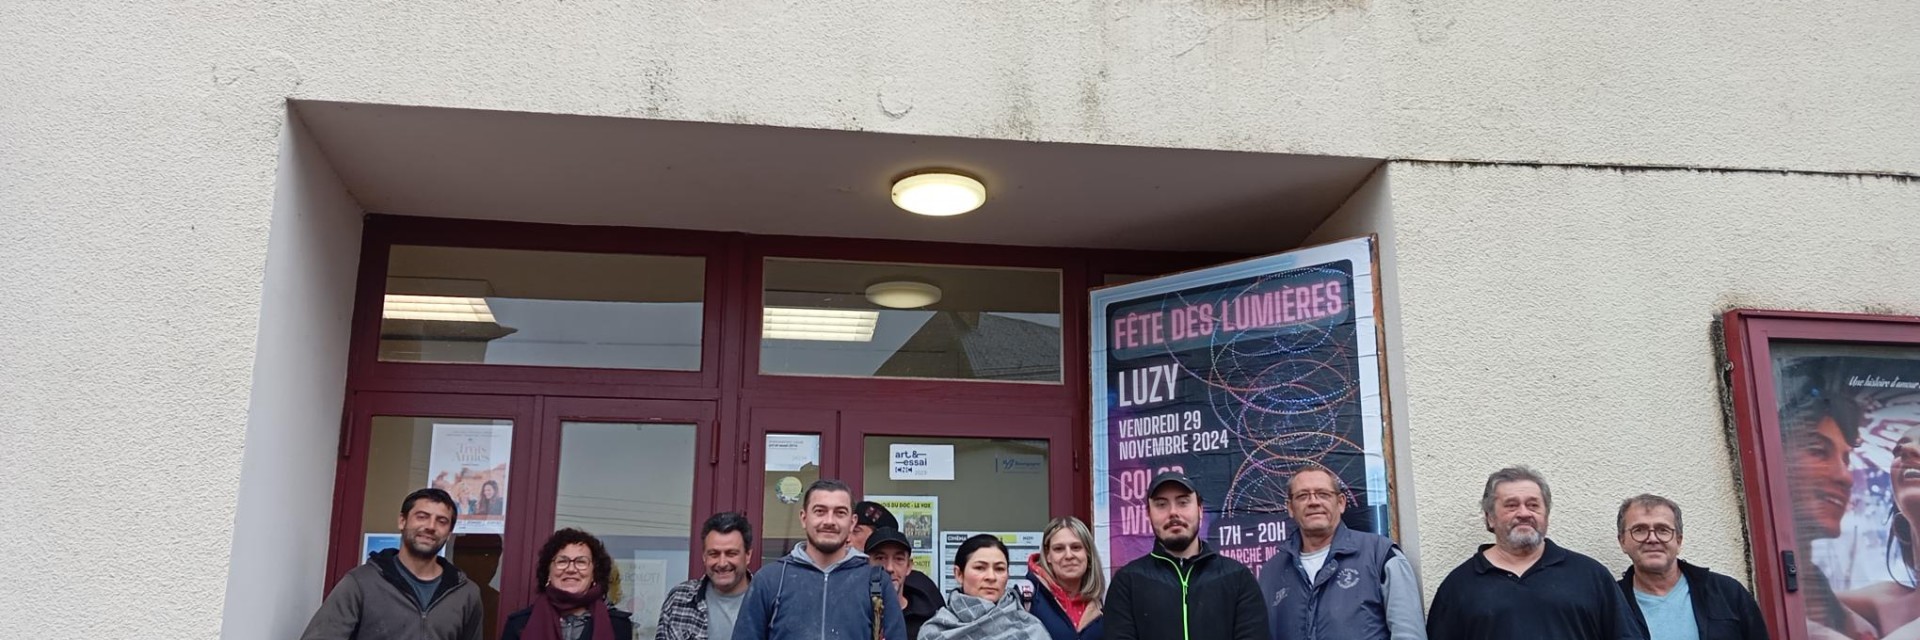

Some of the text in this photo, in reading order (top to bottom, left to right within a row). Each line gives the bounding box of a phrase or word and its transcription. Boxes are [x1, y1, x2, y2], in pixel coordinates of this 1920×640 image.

[1114, 280, 1343, 349] FÊTE DES LUMIÈRES
[1118, 363, 1179, 408] LUZY
[1118, 410, 1201, 439] VENDREDI 29
[895, 451, 911, 459] art
[1119, 429, 1229, 461] NOVEMBRE 2024
[904, 458, 927, 466] essai
[1219, 525, 1241, 546] 17H
[1257, 521, 1287, 543] 20H
